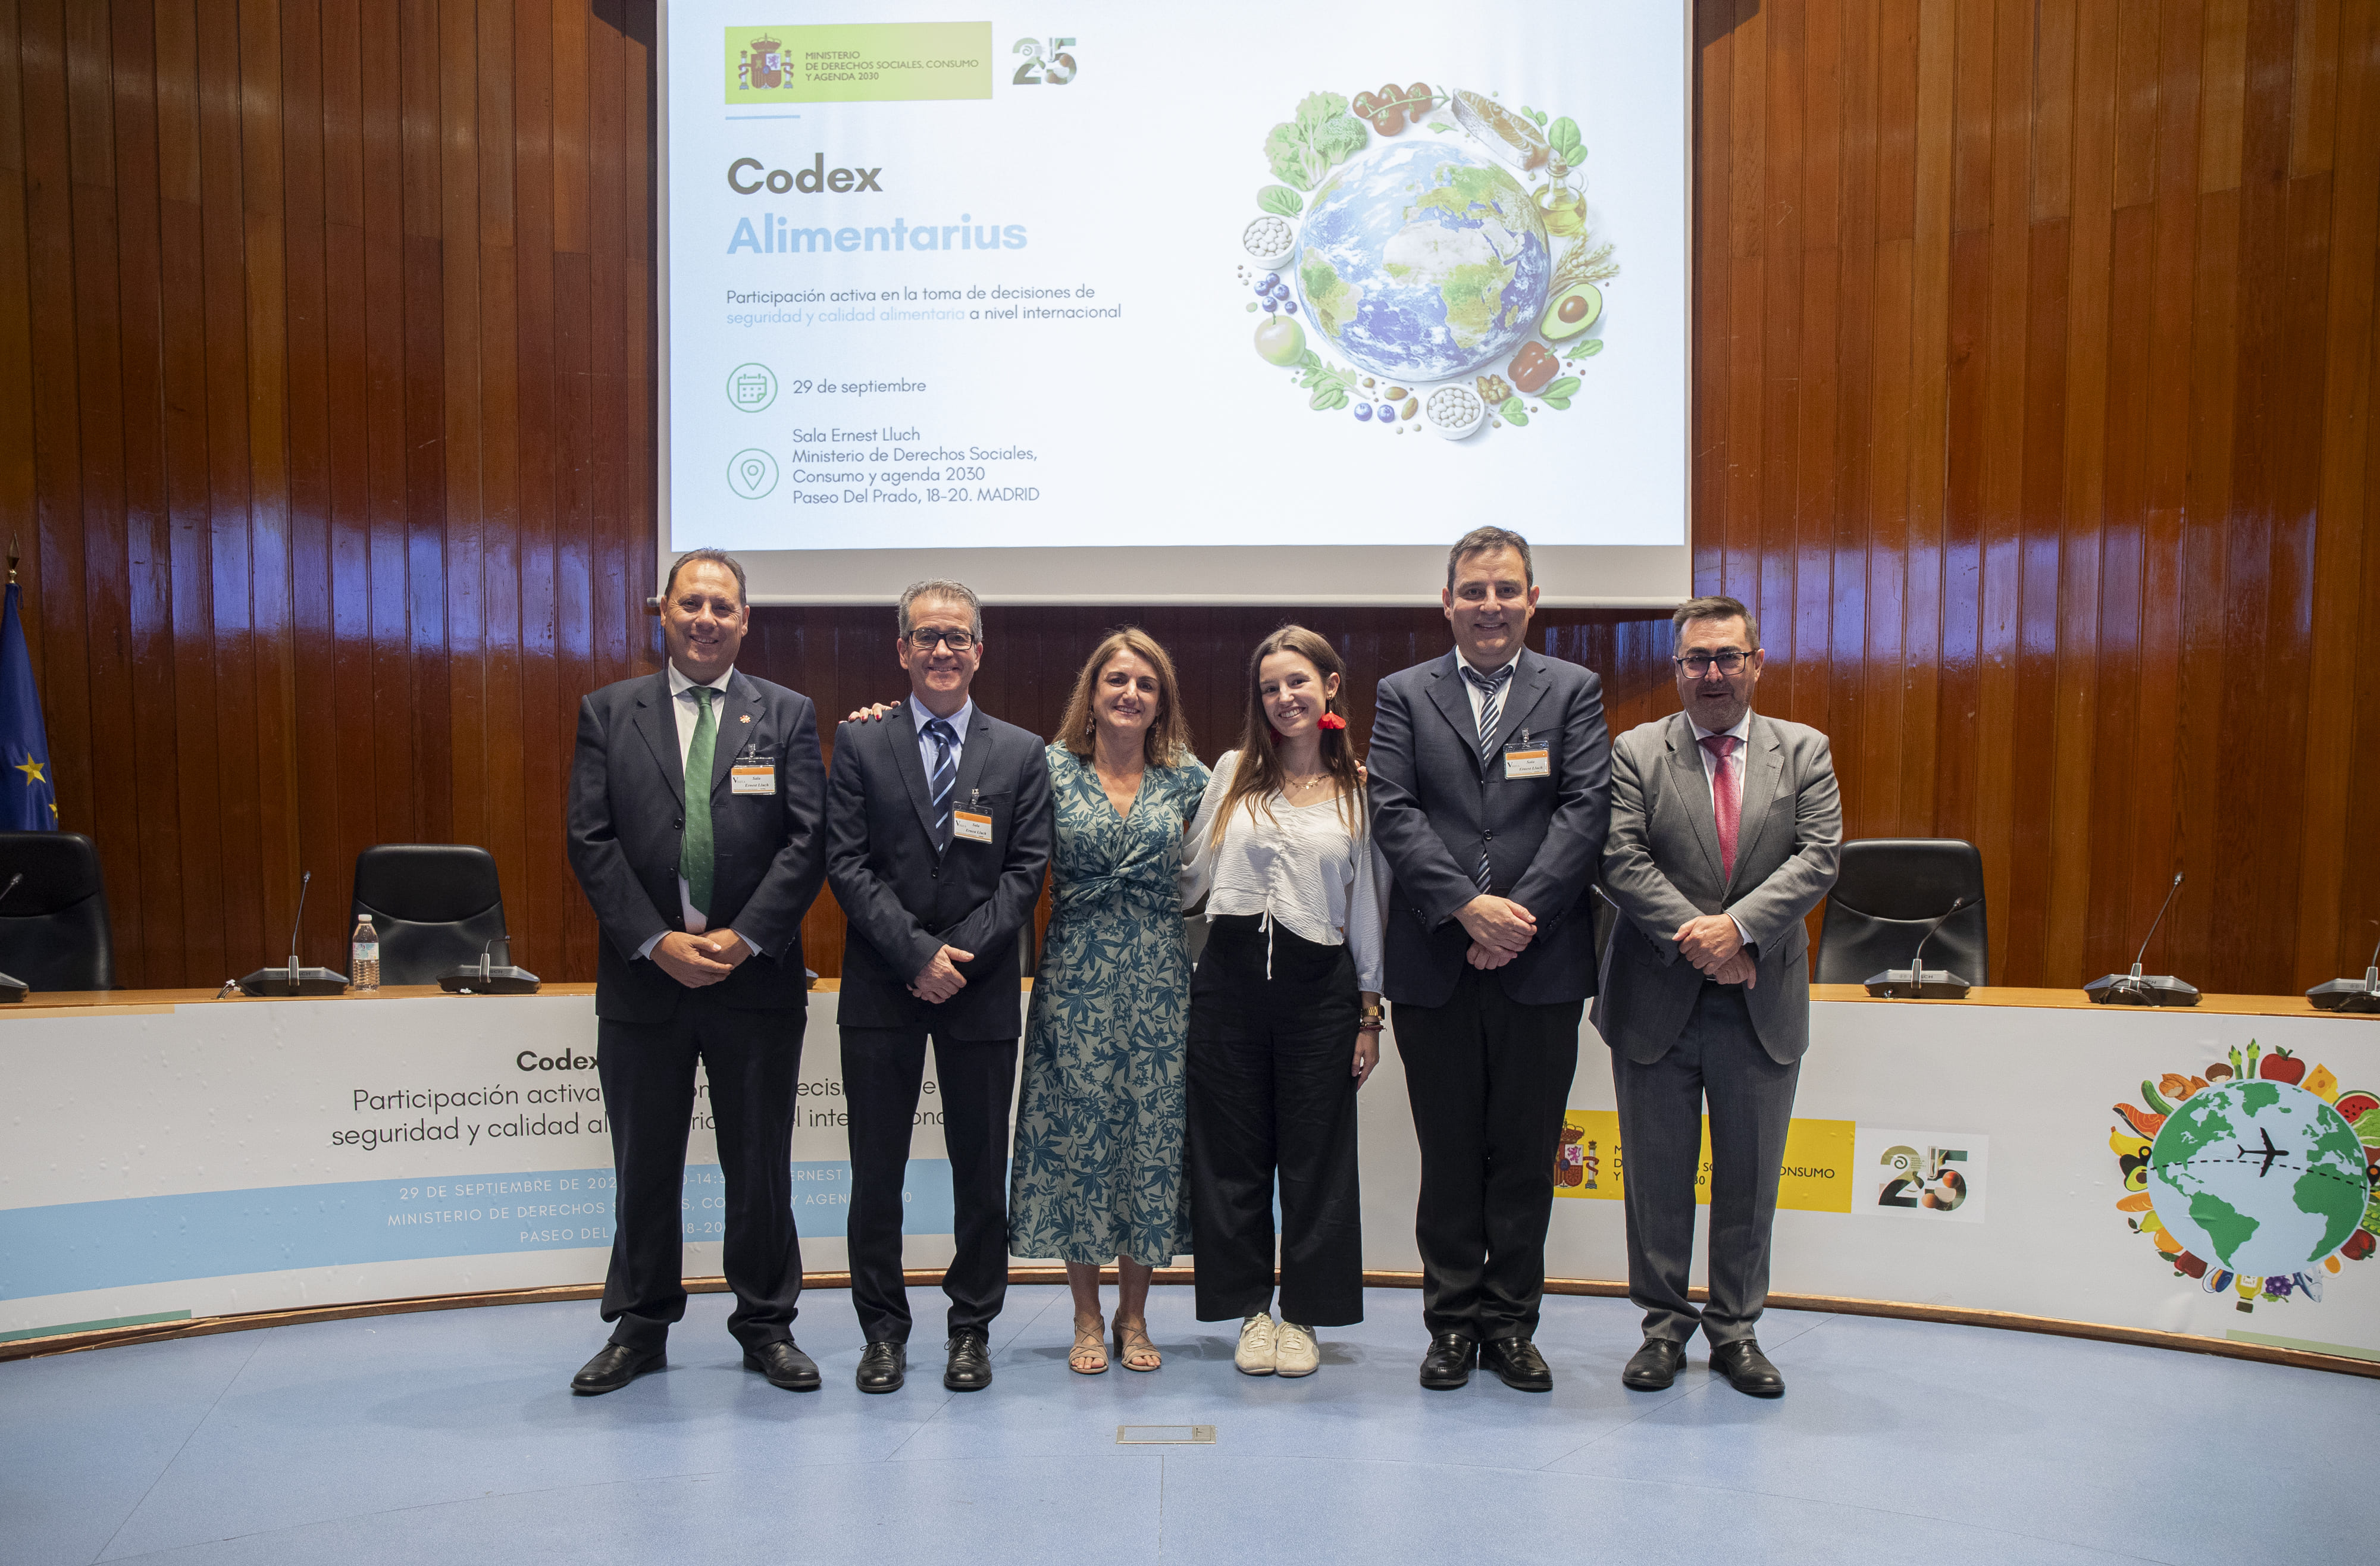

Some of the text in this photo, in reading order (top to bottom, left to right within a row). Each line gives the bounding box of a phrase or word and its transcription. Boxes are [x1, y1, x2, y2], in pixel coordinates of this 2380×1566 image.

[806, 51, 860, 59] MINISTERIO
[822, 61, 873, 70] DERECHOS
[926, 59, 979, 68] CONSUMO
[814, 73, 856, 81] AGENDA
[859, 72, 879, 80] 2030
[728, 152, 882, 195] Codex
[726, 213, 1027, 254] Alimentarius
[727, 284, 1095, 307] Participación activa en la toma de decisiones de
[727, 303, 1120, 328] seguridad y calidad alimentaria a nivel internacional
[793, 377, 926, 397] 29 de septiembre
[793, 427, 920, 443] Sala Ernest Lluch
[793, 445, 1036, 462] Ministerio de Derechos Sociales,
[793, 466, 985, 486] Consumo y agenda 2030
[794, 487, 1039, 504] Paseo Del Prado, 18-20. MADRID
[354, 1084, 518, 1114] Participación
[528, 1084, 600, 1103] activa
[333, 1117, 458, 1151] seguridad
[468, 1125, 480, 1145] y
[488, 1112, 578, 1137] calidad
[1781, 1166, 1835, 1179] ONSUMO
[400, 1187, 418, 1199] 29
[427, 1186, 446, 1197] DE
[455, 1179, 551, 1196] SEPTIEMBRE
[560, 1179, 579, 1190] DE
[587, 1177, 616, 1189] 202
[389, 1209, 481, 1226] MINISTERIO
[490, 1207, 509, 1219] DE
[518, 1202, 605, 1217] DERECHOS
[806, 1194, 847, 1205] AGEN
[521, 1229, 573, 1242] PASEO
[581, 1227, 609, 1239] DEL
